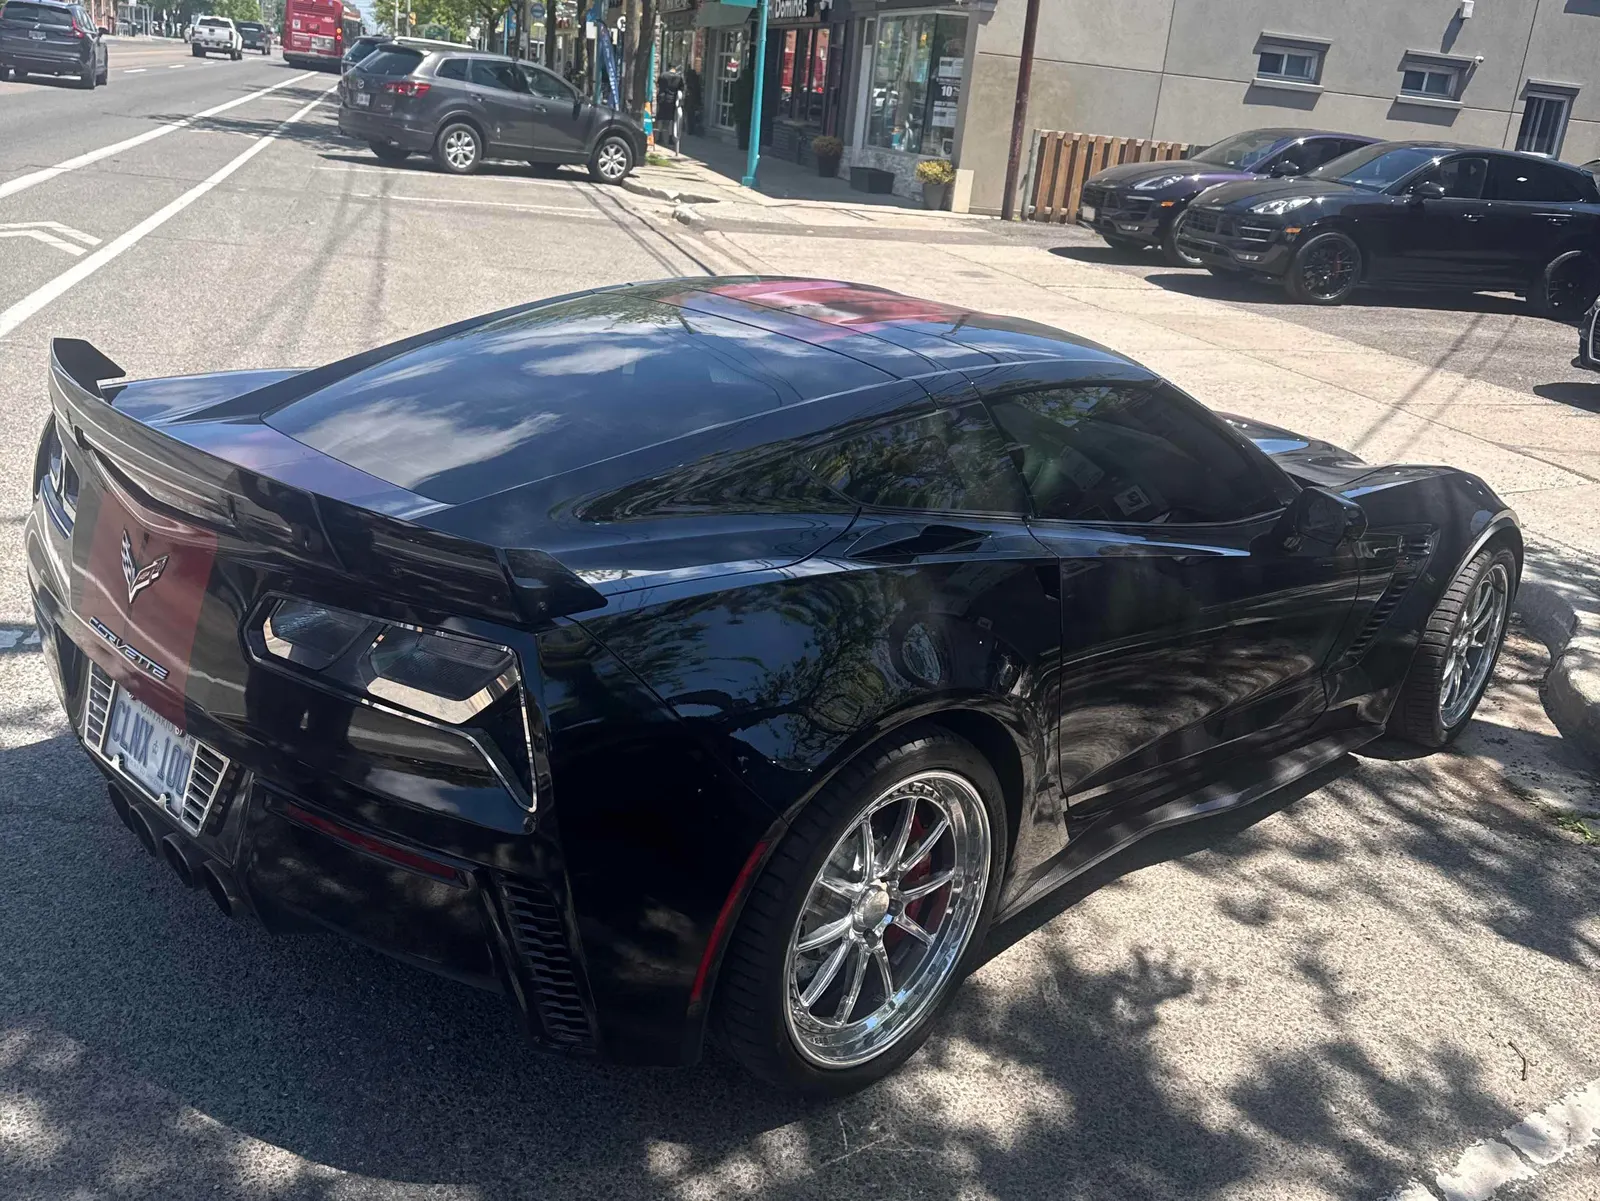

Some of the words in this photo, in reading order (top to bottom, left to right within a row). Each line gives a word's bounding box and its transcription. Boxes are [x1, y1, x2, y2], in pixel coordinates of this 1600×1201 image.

[88, 616, 168, 680] CORVETTE
[111, 701, 155, 769] CLNX
[157, 736, 191, 796] 100
